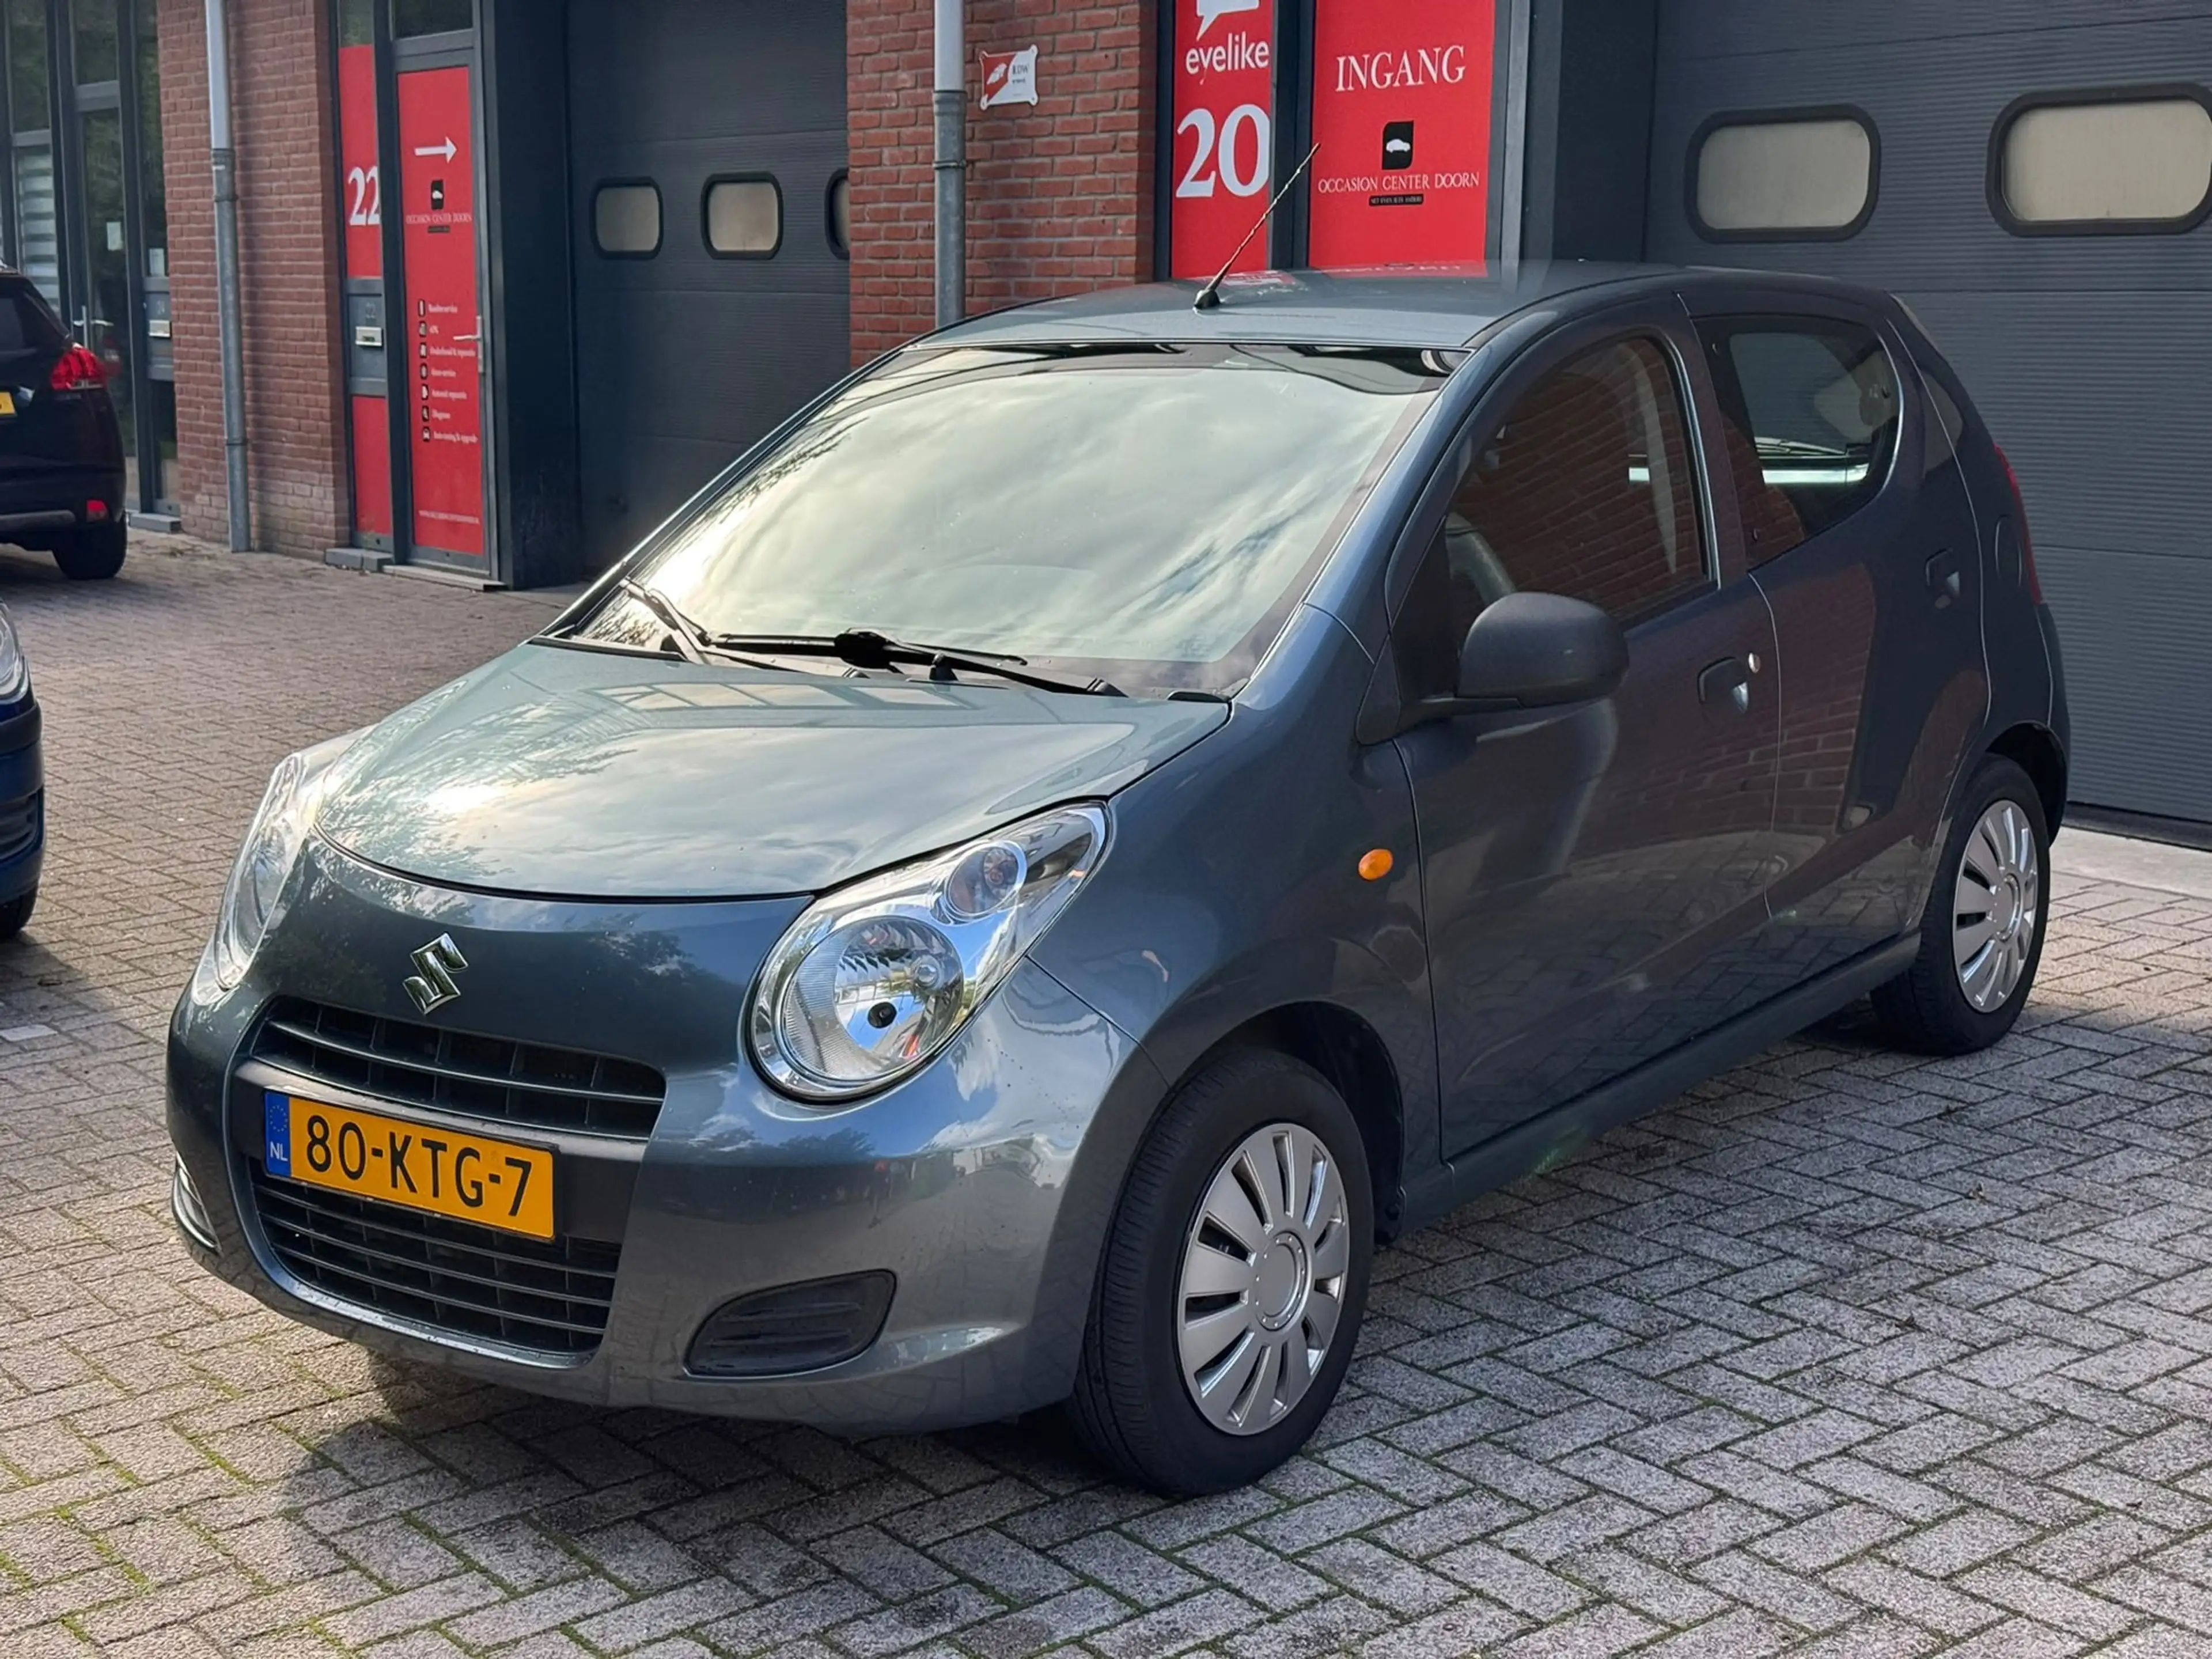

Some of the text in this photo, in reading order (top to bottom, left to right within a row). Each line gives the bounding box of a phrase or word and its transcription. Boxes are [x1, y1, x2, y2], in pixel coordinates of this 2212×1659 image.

[1335, 45, 1466, 92] INGANG
[1176, 104, 1270, 198] 20
[348, 166, 380, 226] 22
[1318, 172, 1480, 193] OCCASION CENTER DOORN
[270, 1141, 288, 1162] NL
[306, 1115, 532, 1217] 80-KTG-7
